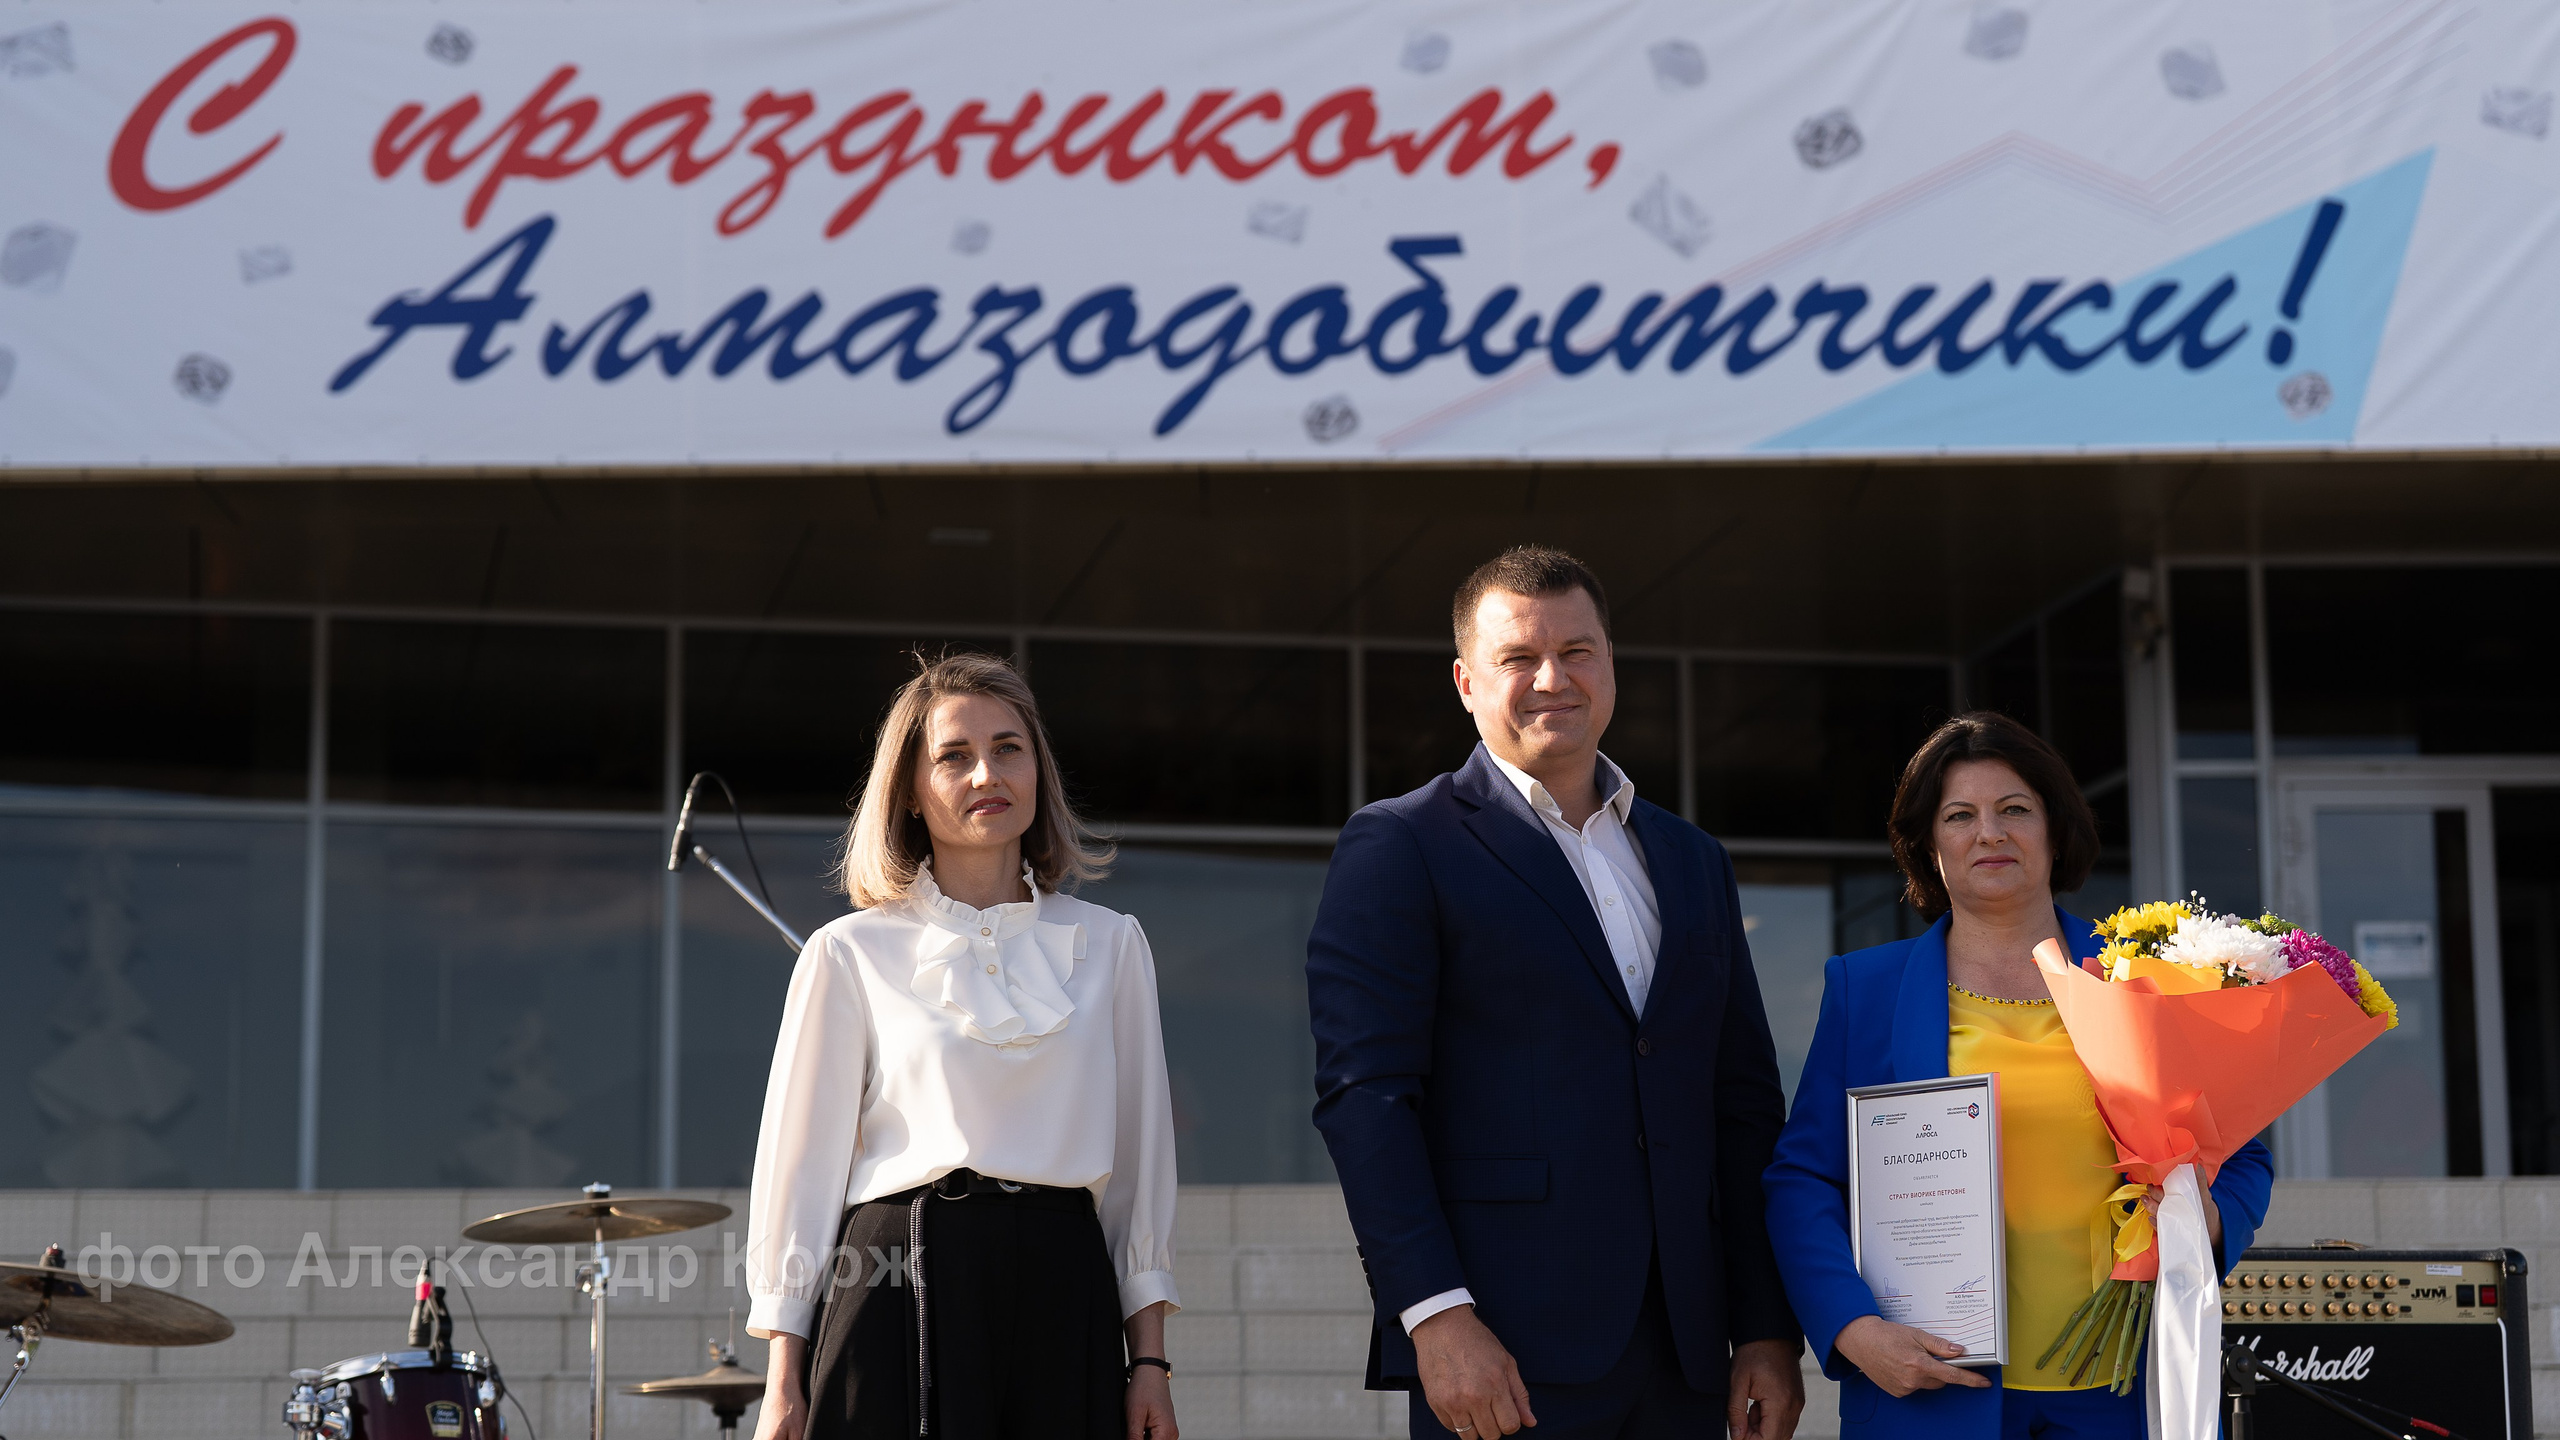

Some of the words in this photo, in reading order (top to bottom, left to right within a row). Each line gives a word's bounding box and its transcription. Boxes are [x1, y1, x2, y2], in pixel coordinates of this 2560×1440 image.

[107, 16, 298, 214] С
[371, 63, 1623, 241] праздником,
[327, 197, 2345, 437] Алмазодобытчики!
[1883, 1149, 1968, 1165] БЛАГОДАРНОСТЬ
[1911, 1190, 1936, 1198] ВИОРИКЕ
[1937, 1187, 1966, 1196] ПЕТРОВНЕ
[2411, 1288, 2447, 1298] JVM
